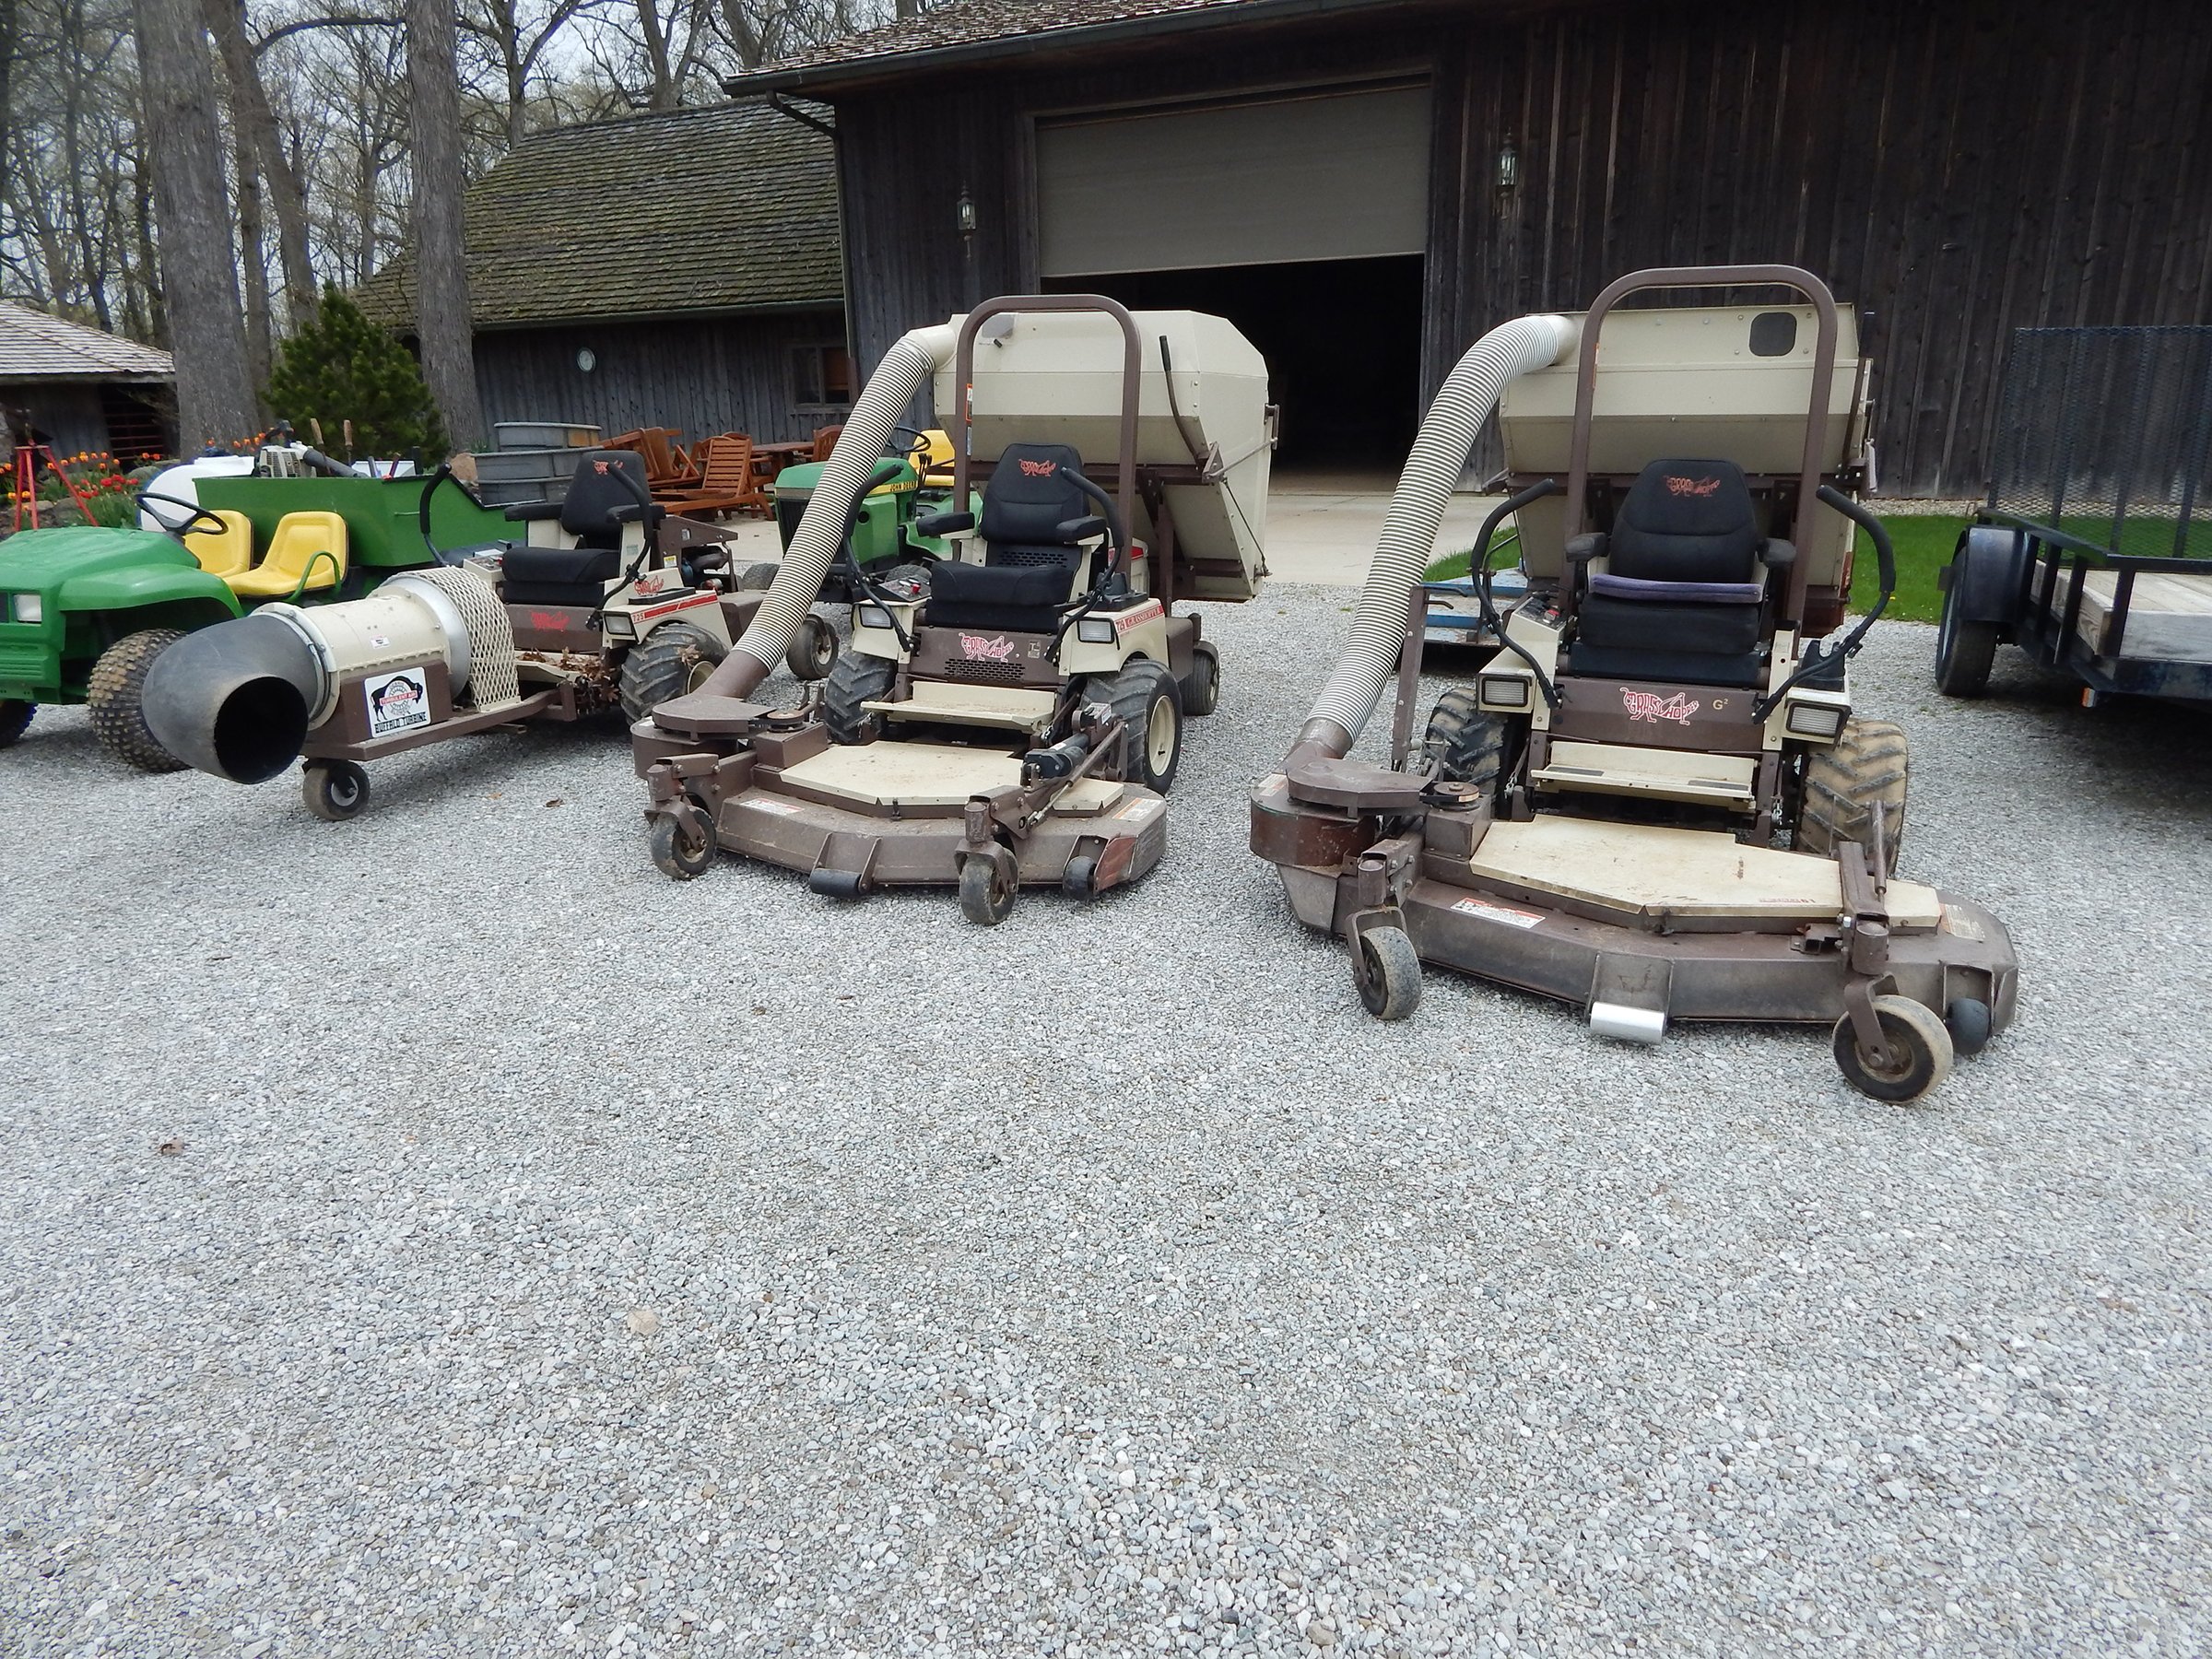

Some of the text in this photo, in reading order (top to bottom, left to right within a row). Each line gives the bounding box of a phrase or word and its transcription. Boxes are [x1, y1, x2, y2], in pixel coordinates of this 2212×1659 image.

[889, 480, 917, 492] JOHN DEERE
[632, 612, 644, 622] 725
[382, 694, 407, 705] TURBULENT
[1622, 689, 1699, 722] GRASSHOPPER
